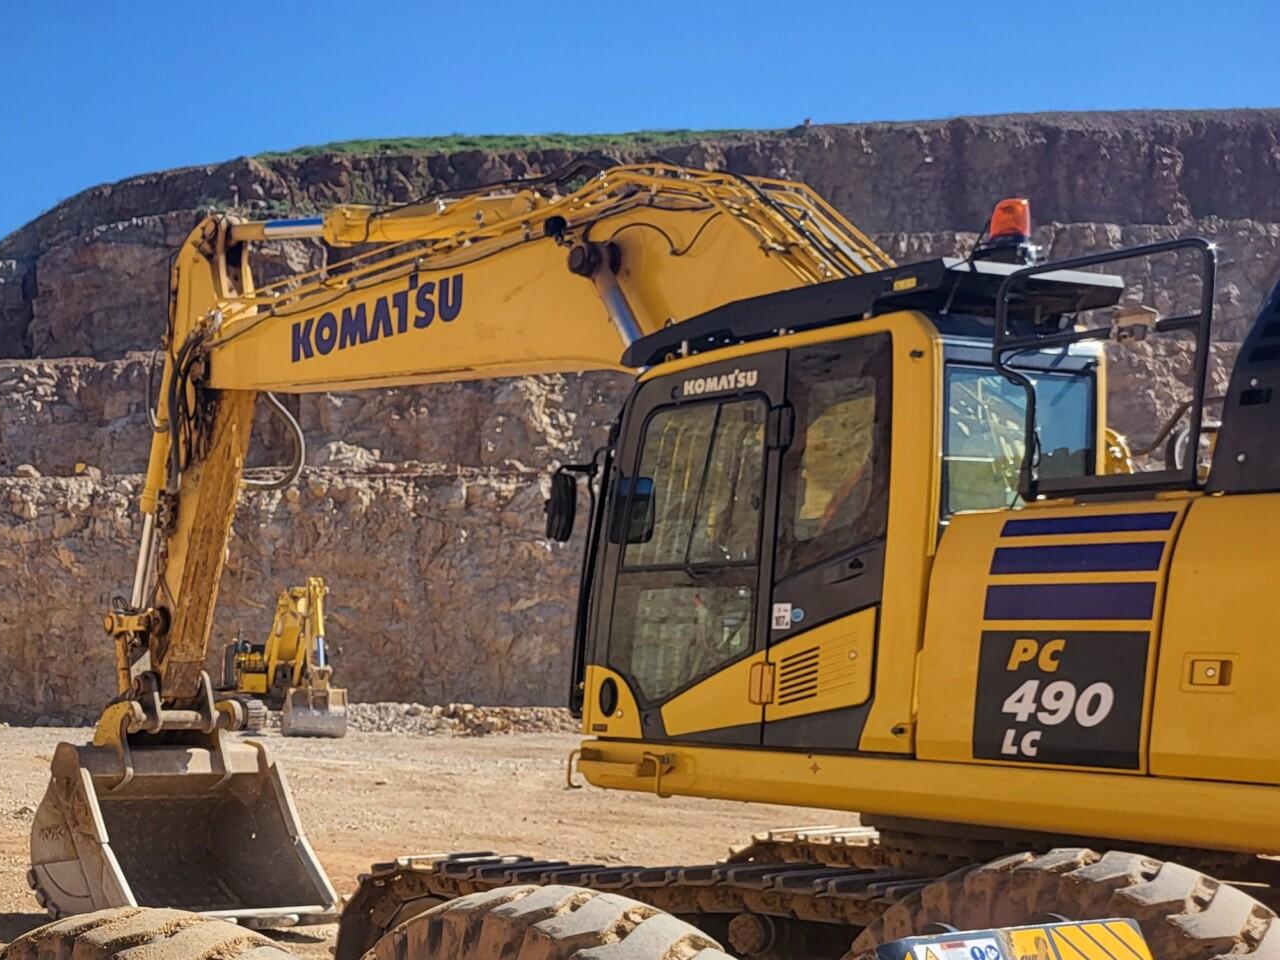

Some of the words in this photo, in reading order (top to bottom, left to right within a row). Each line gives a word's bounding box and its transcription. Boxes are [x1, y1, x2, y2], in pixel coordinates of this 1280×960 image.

[291, 273, 463, 363] KOMATSU
[683, 369, 758, 396] KOMATSU
[1006, 639, 1066, 672] PC
[1001, 679, 1114, 727] 490
[1001, 728, 1042, 757] LC
